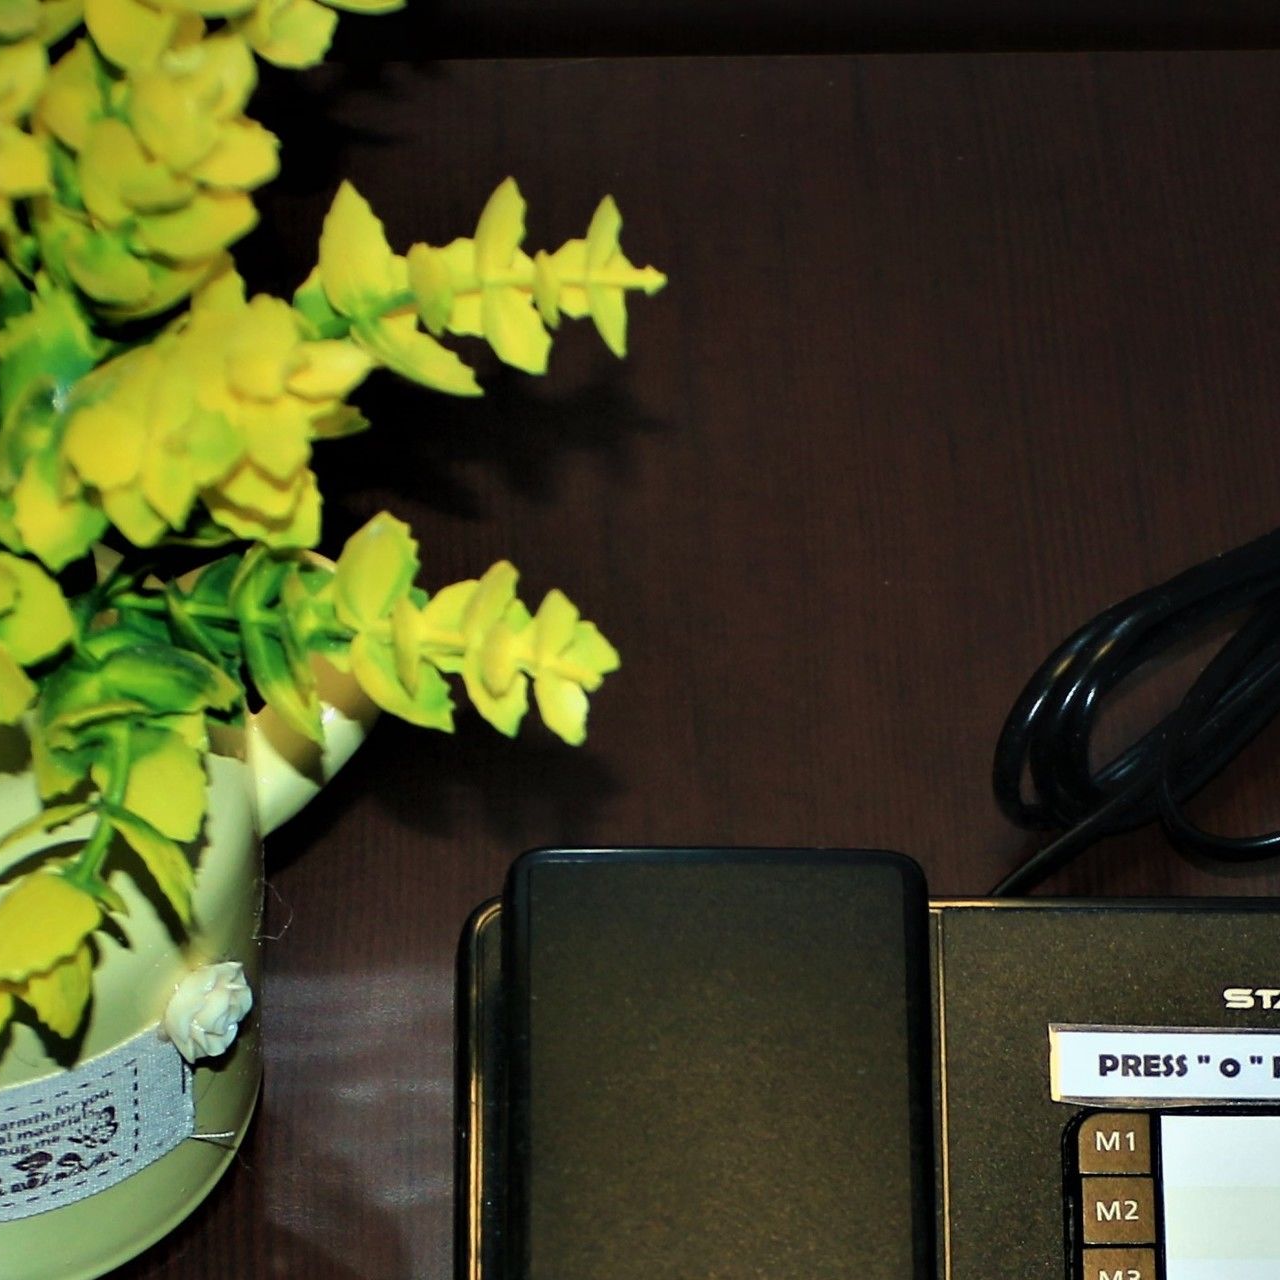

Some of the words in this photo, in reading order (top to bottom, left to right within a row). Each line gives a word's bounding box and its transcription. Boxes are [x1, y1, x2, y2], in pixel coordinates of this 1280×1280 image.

[1098, 1054, 1189, 1078] PRESS
[55, 1103, 76, 1117] for
[35, 1135, 60, 1149] me
[1096, 1131, 1135, 1152] M1
[1096, 1200, 1139, 1222] M2
